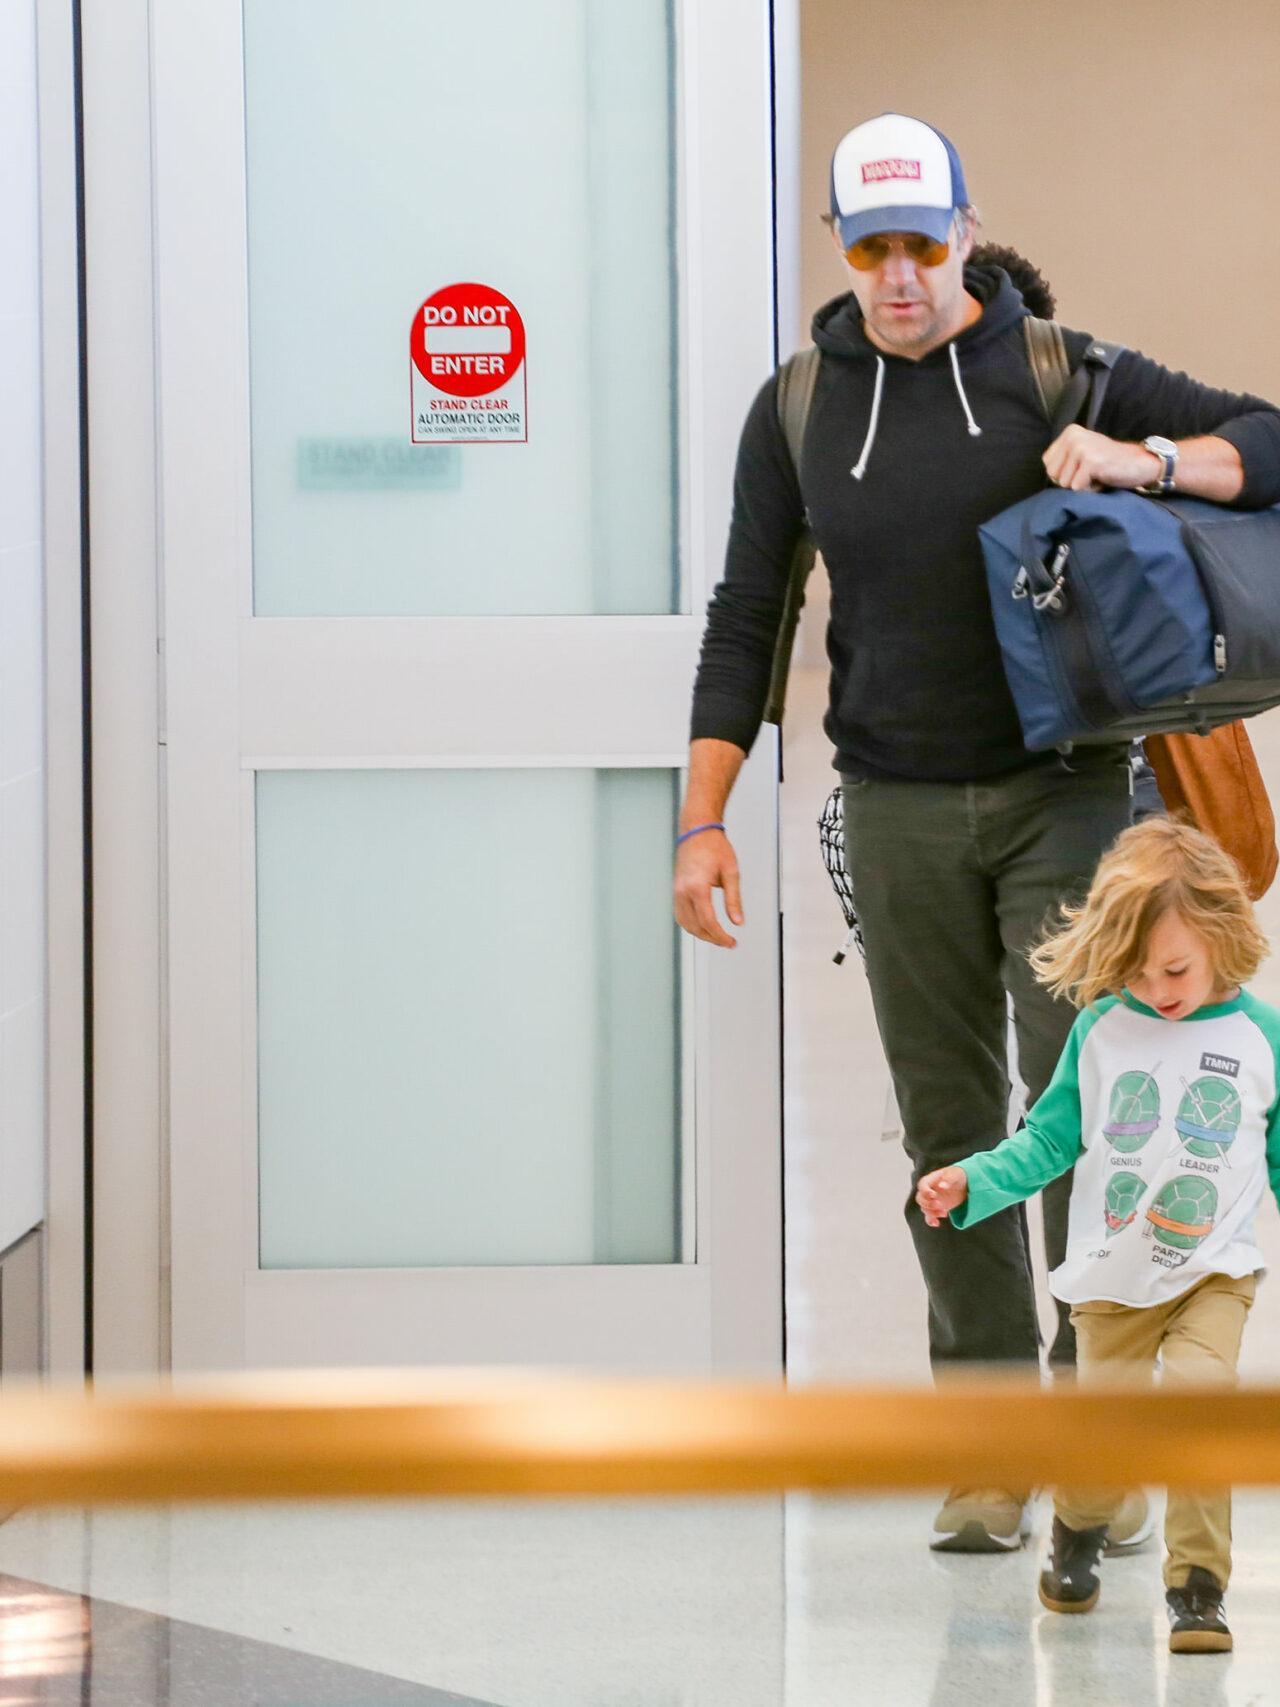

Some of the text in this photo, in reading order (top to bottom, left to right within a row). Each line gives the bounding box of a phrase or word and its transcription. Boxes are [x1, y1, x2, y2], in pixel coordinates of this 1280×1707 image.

[424, 305, 511, 325] DO NOT
[431, 356, 505, 375] ENTER
[430, 399, 509, 411] STAND CLEAR
[418, 412, 521, 424] AUTOMATIC DOOR
[1204, 1056, 1238, 1073] TMNT
[1110, 1157, 1143, 1167] GENIUS
[1179, 1158, 1220, 1173] LEADER
